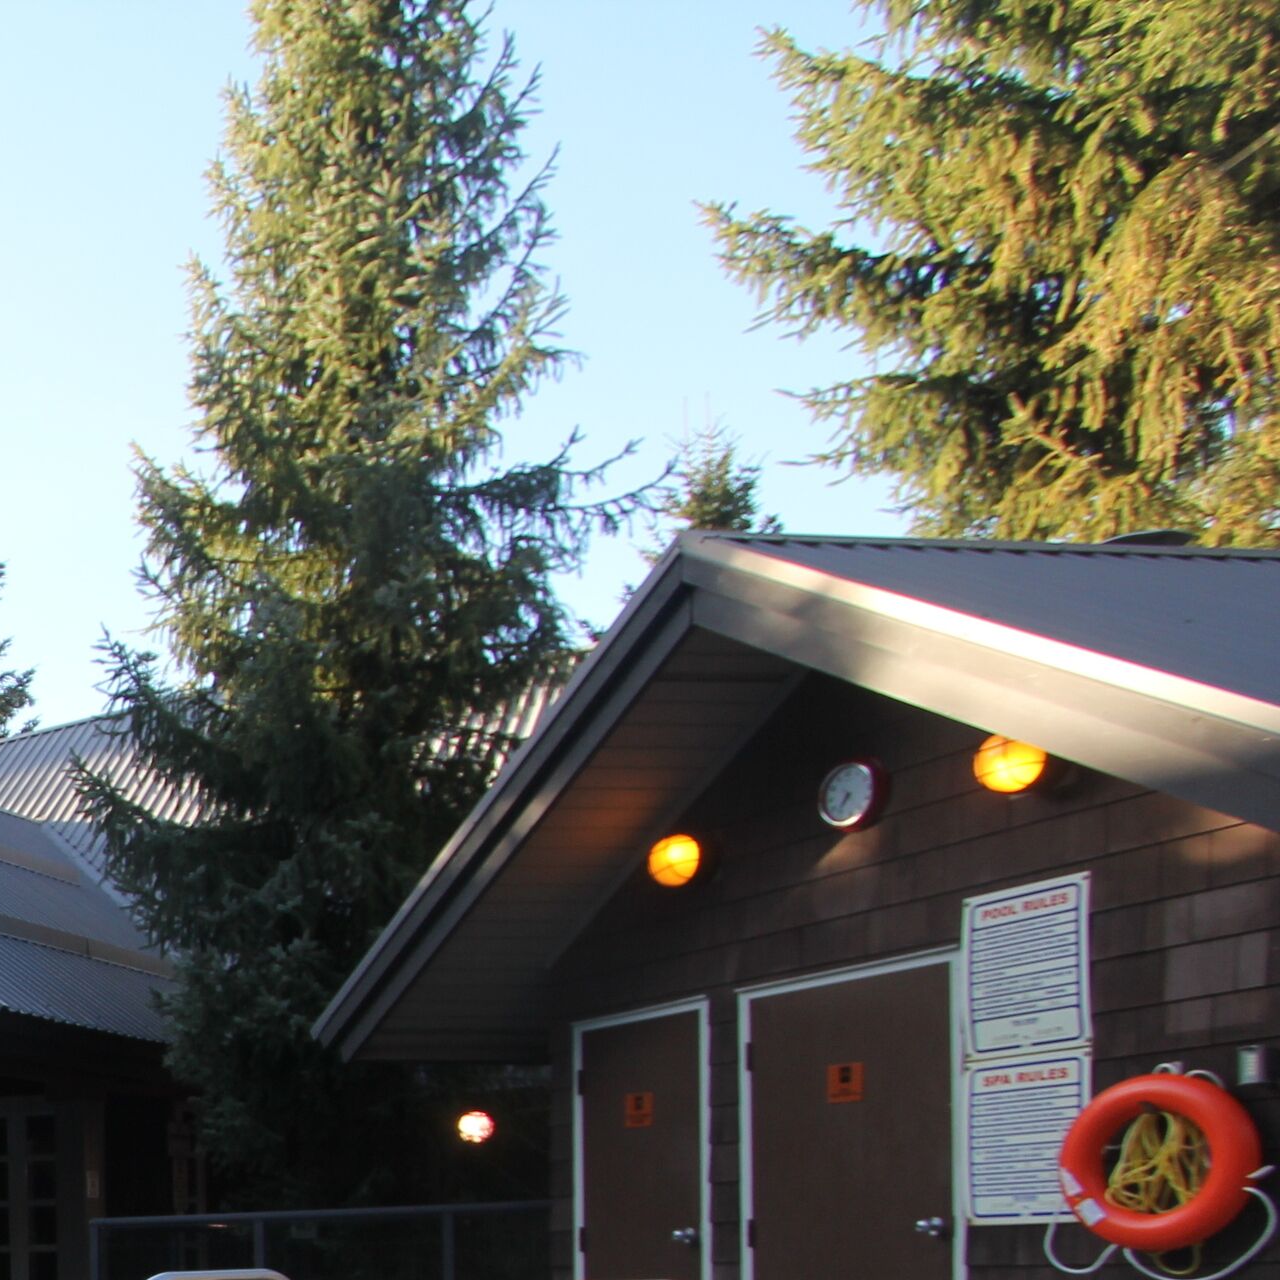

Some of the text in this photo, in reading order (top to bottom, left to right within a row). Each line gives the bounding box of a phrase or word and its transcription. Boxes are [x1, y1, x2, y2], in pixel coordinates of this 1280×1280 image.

[981, 892, 1069, 922] POOL RULES
[983, 1067, 1069, 1087] SPA RULES
